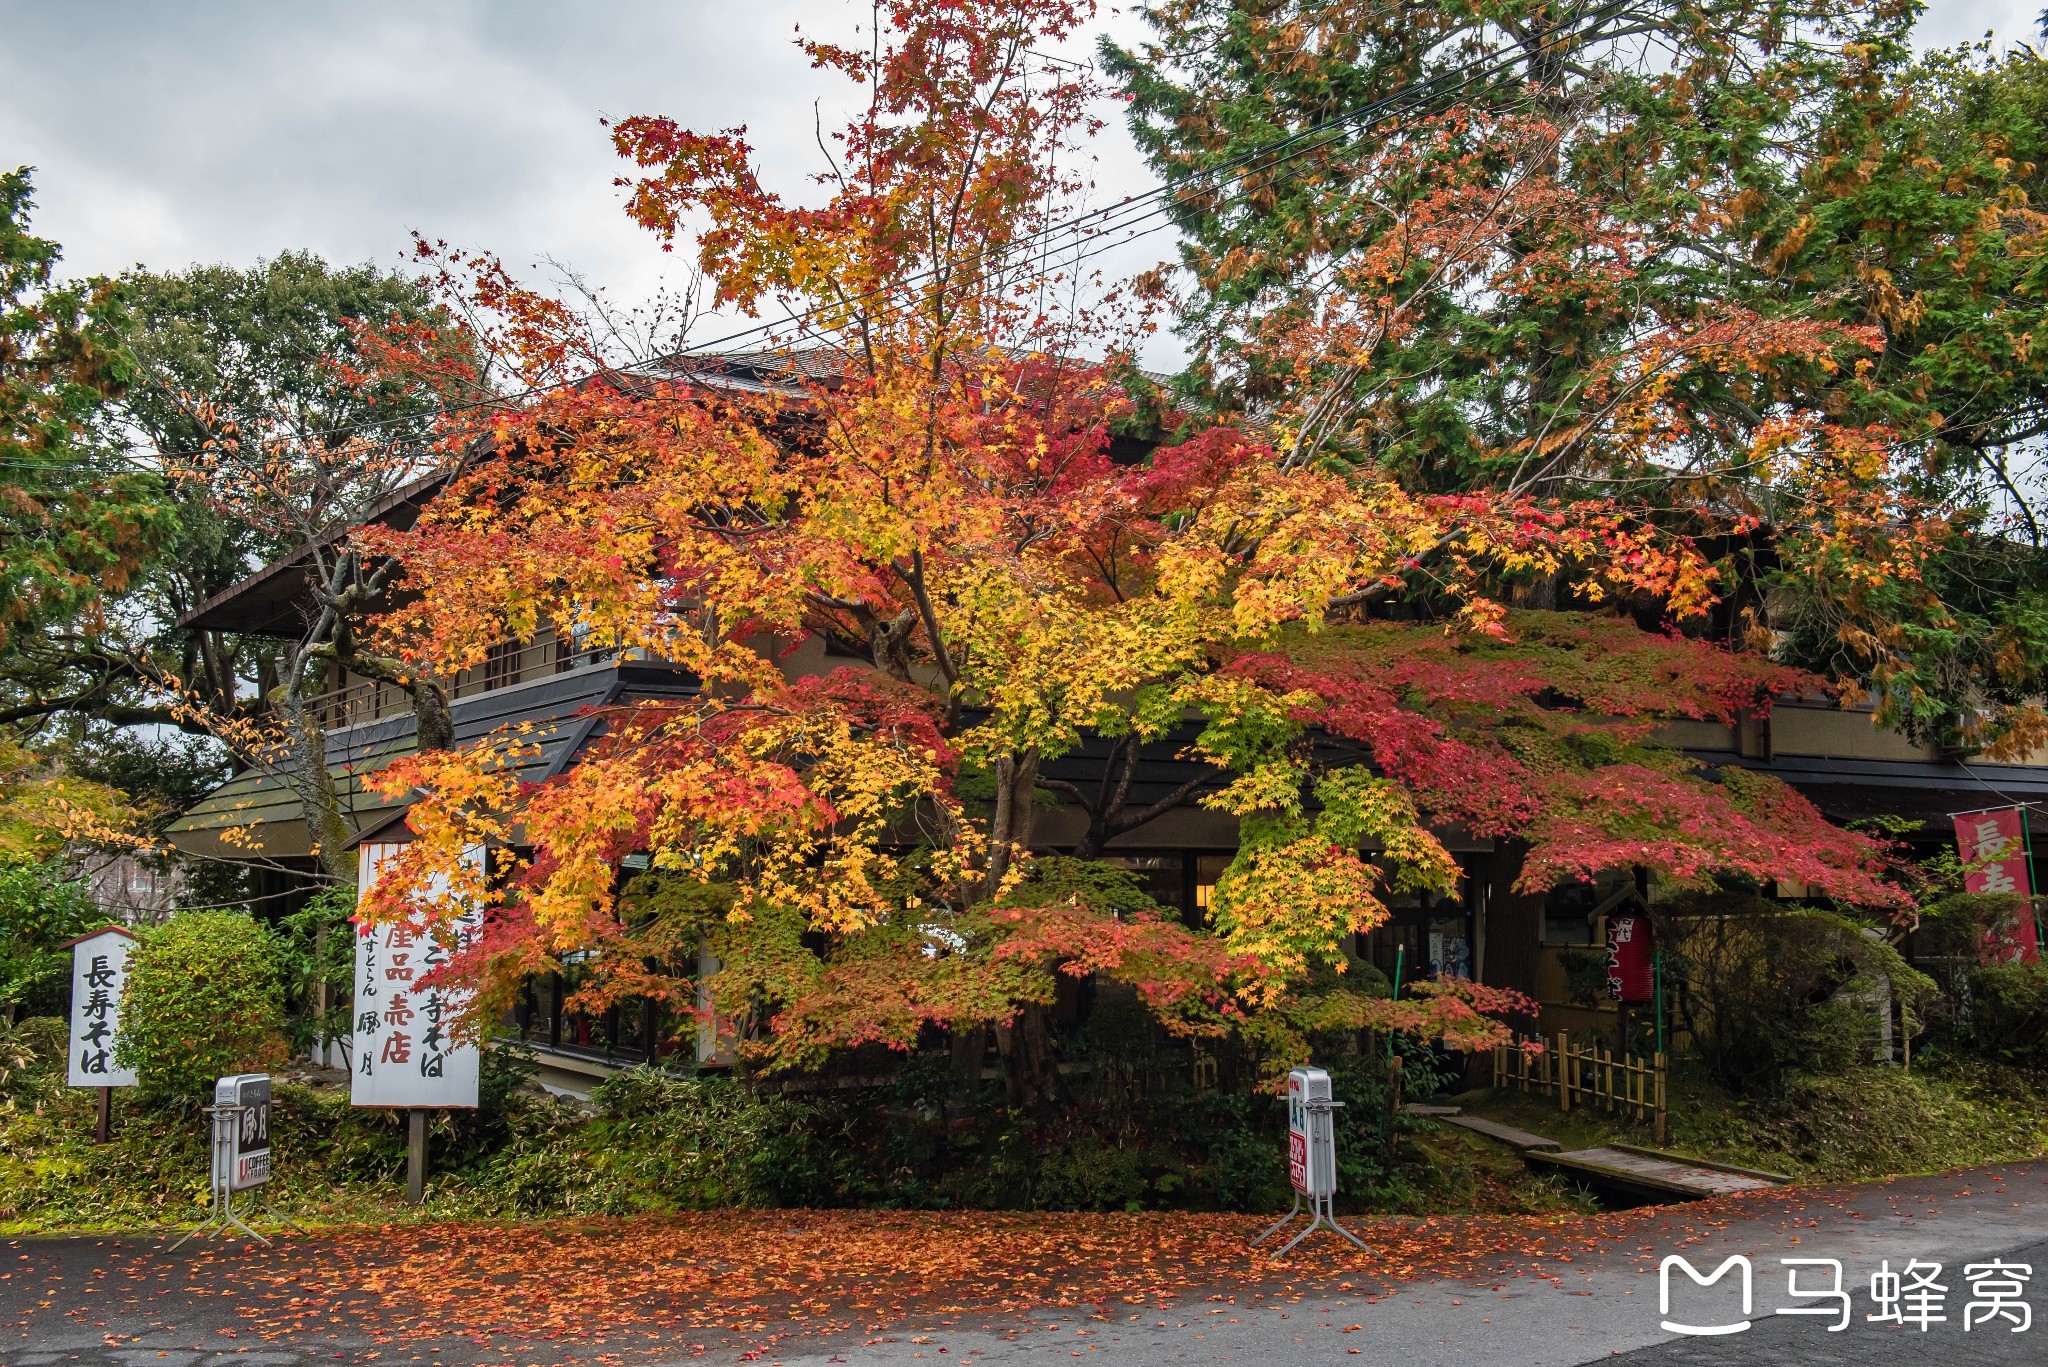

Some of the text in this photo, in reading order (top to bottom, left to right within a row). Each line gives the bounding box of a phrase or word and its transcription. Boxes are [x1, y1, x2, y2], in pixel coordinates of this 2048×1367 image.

[80, 955, 117, 1074] 長寿そば
[356, 926, 381, 1076] すとらん 風月
[248, 1153, 270, 1170] COFFEE
